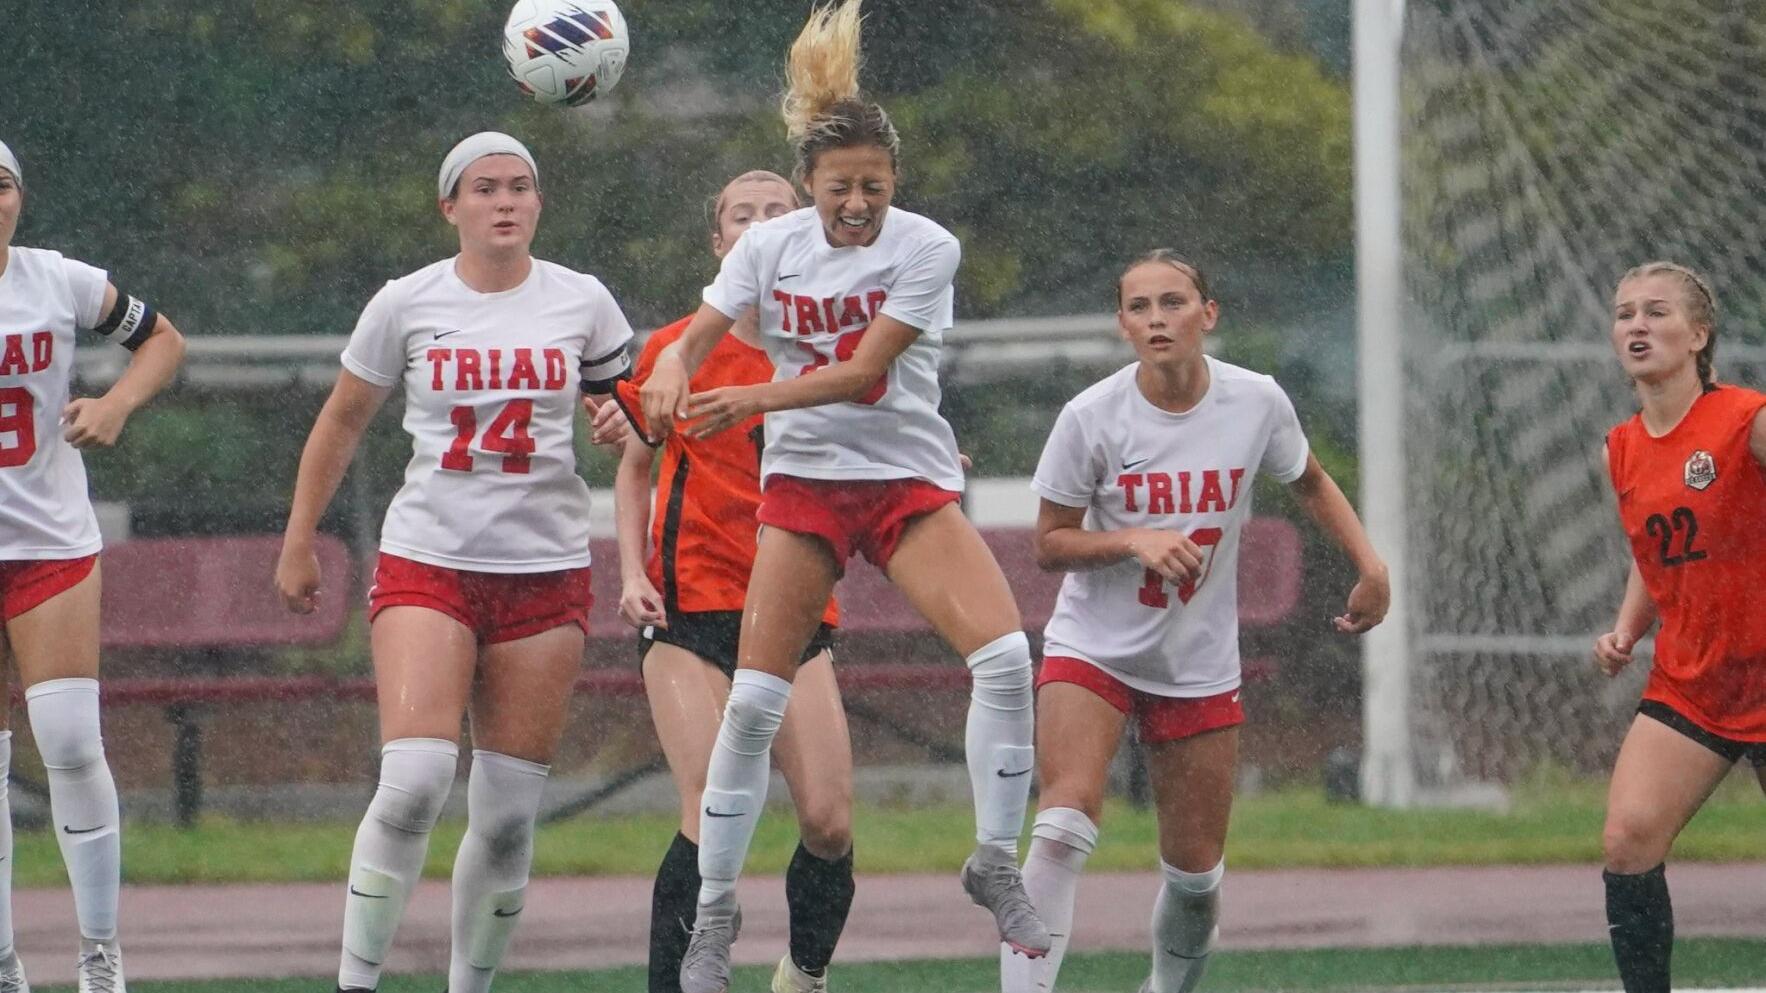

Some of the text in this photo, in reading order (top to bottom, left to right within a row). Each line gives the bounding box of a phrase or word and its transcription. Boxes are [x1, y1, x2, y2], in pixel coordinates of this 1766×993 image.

[426, 347, 567, 391] TRIAD
[440, 398, 536, 474] 14
[1645, 506, 1708, 567] 22
